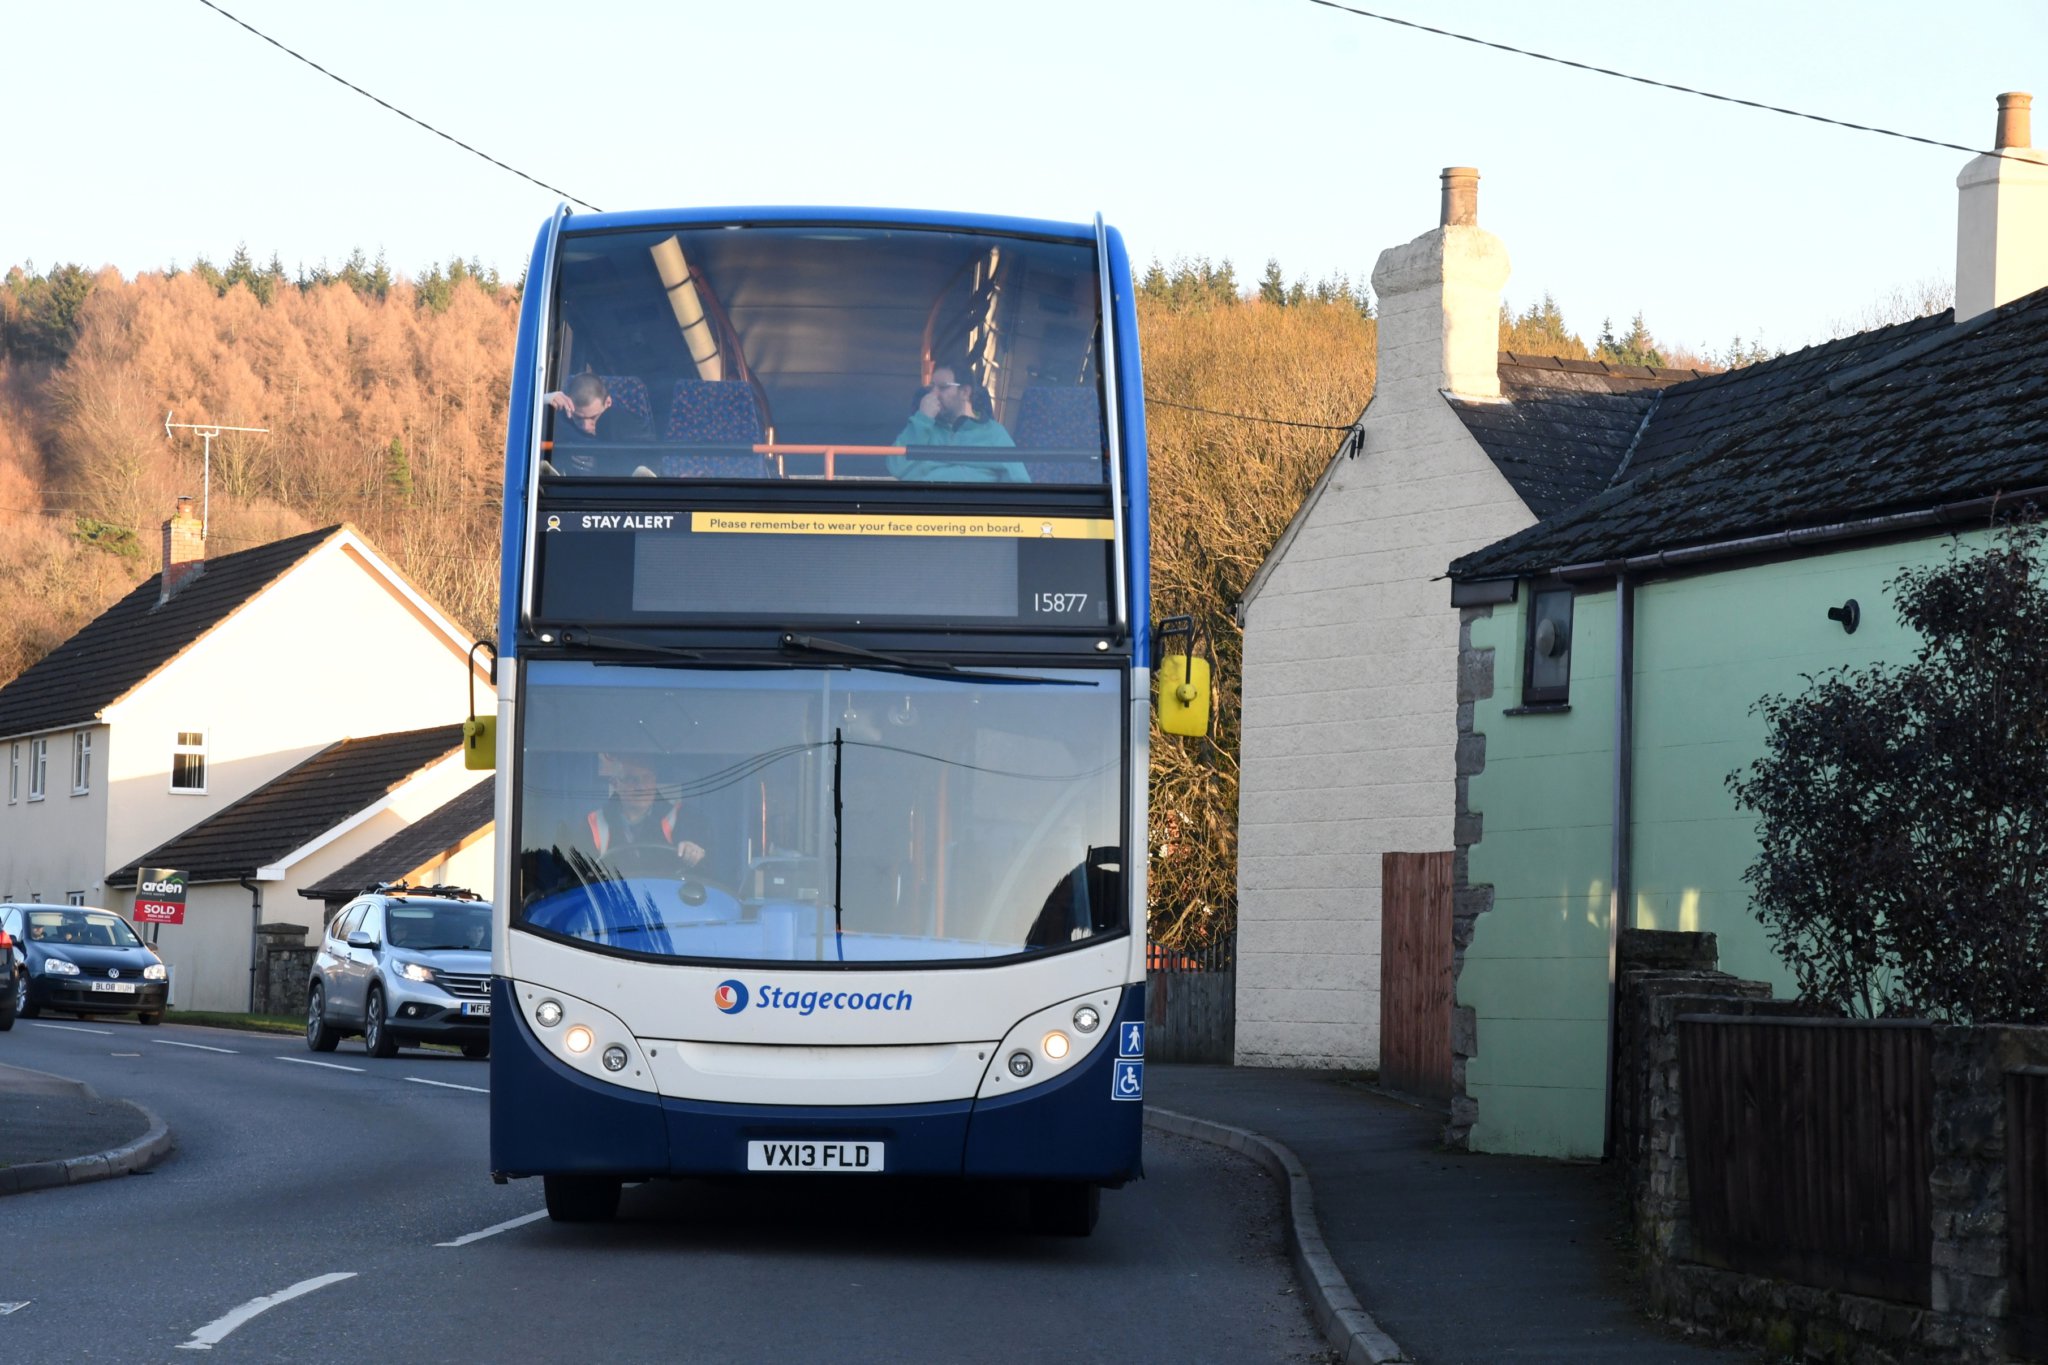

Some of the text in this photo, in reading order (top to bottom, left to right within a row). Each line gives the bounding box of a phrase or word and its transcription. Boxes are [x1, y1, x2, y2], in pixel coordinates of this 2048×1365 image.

[582, 515, 674, 529] STAY ALERT
[710, 518, 1024, 535] Please remember to wear your face covering on board.
[1034, 592, 1088, 613] 15877
[142, 879, 183, 894] arden
[144, 904, 176, 915] SOLD
[756, 985, 912, 1016] Stagecoach
[763, 1144, 870, 1167] VX13 FLD
